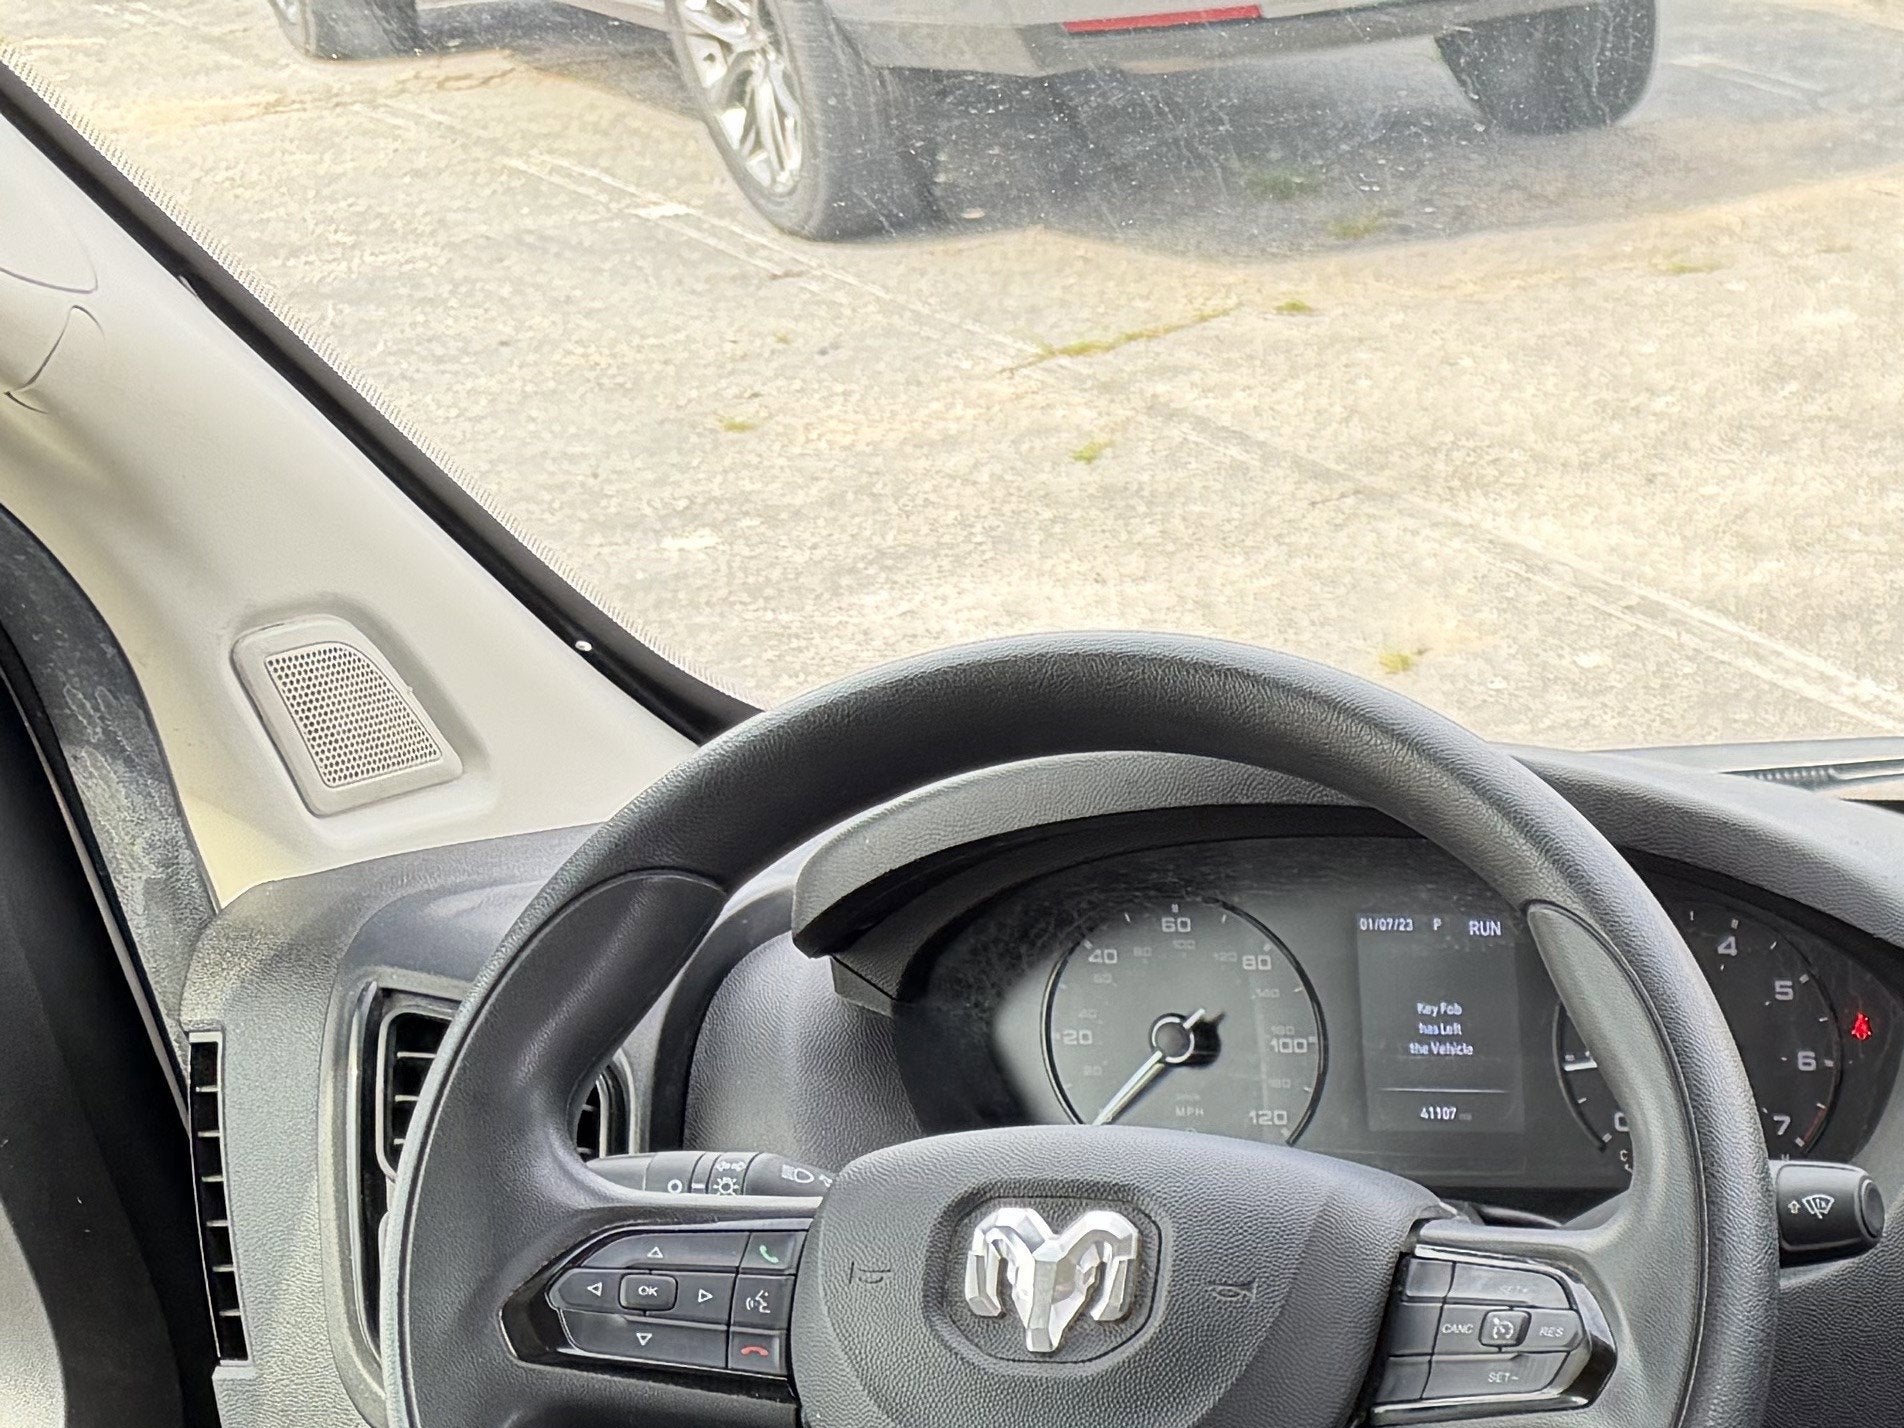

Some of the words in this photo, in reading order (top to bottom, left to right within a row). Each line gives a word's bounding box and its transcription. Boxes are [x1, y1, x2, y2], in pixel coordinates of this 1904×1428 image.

[1161, 917, 1191, 933] 60
[1359, 918, 1414, 932] 01/07/23
[1433, 918, 1442, 931] P
[1469, 920, 1502, 936] RUN
[1717, 936, 1737, 957] 4
[1088, 949, 1118, 964] 40
[1242, 955, 1272, 970] 80
[1774, 980, 1794, 1001] 5
[1416, 1002, 1438, 1017] Key
[1440, 1002, 1463, 1016] Fob
[1062, 1029, 1093, 1045] 20
[1269, 1038, 1307, 1053] 100
[1409, 1042, 1429, 1055] the
[1430, 1042, 1474, 1056] Vehicle
[1797, 1050, 1817, 1072] 6
[1175, 1106, 1204, 1117] MPH
[1249, 1110, 1288, 1125] 120
[1419, 1107, 1457, 1120] 41107
[1773, 1115, 1791, 1136] 7
[1620, 1149, 1628, 1162] C
[638, 1285, 658, 1297] OK
[1441, 1323, 1474, 1335] CANC
[1538, 1327, 1564, 1338] RES
